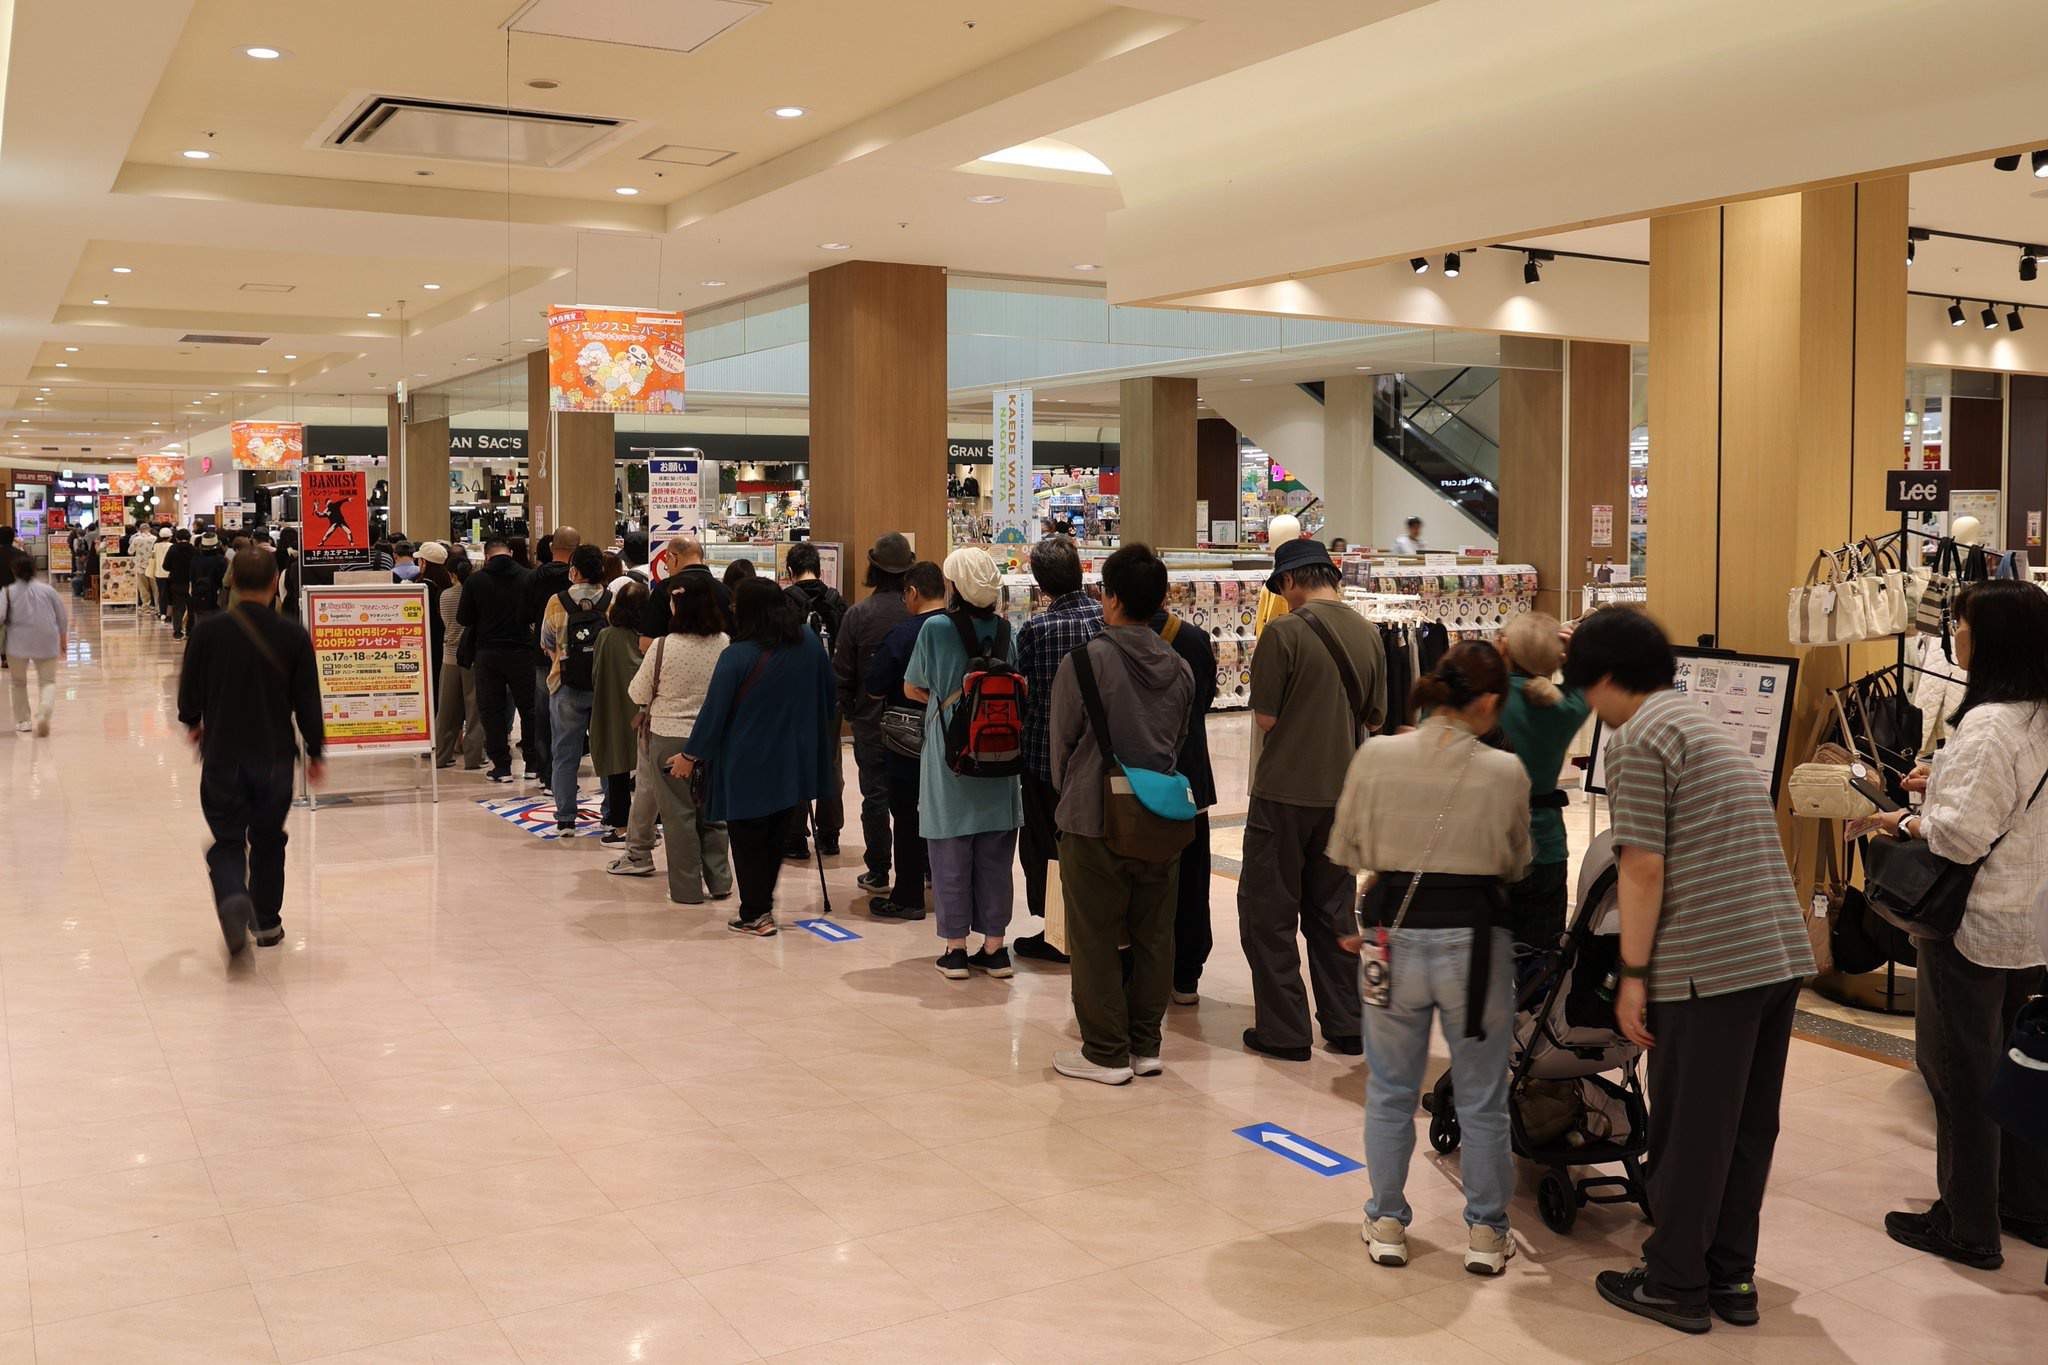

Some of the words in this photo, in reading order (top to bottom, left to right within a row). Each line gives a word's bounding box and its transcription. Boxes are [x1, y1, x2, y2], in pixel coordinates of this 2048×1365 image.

[1008, 394, 1016, 455] KAEDE
[449, 436, 472, 448] AN
[949, 445, 983, 457] GRAN
[660, 462, 687, 472] お願い
[310, 474, 357, 488] BANKSY
[1008, 460, 1016, 514] WALK
[1899, 480, 1937, 501] Lee
[316, 627, 422, 638] 専門店100円引クーポン券
[316, 637, 398, 648] 200円分プレゼント
